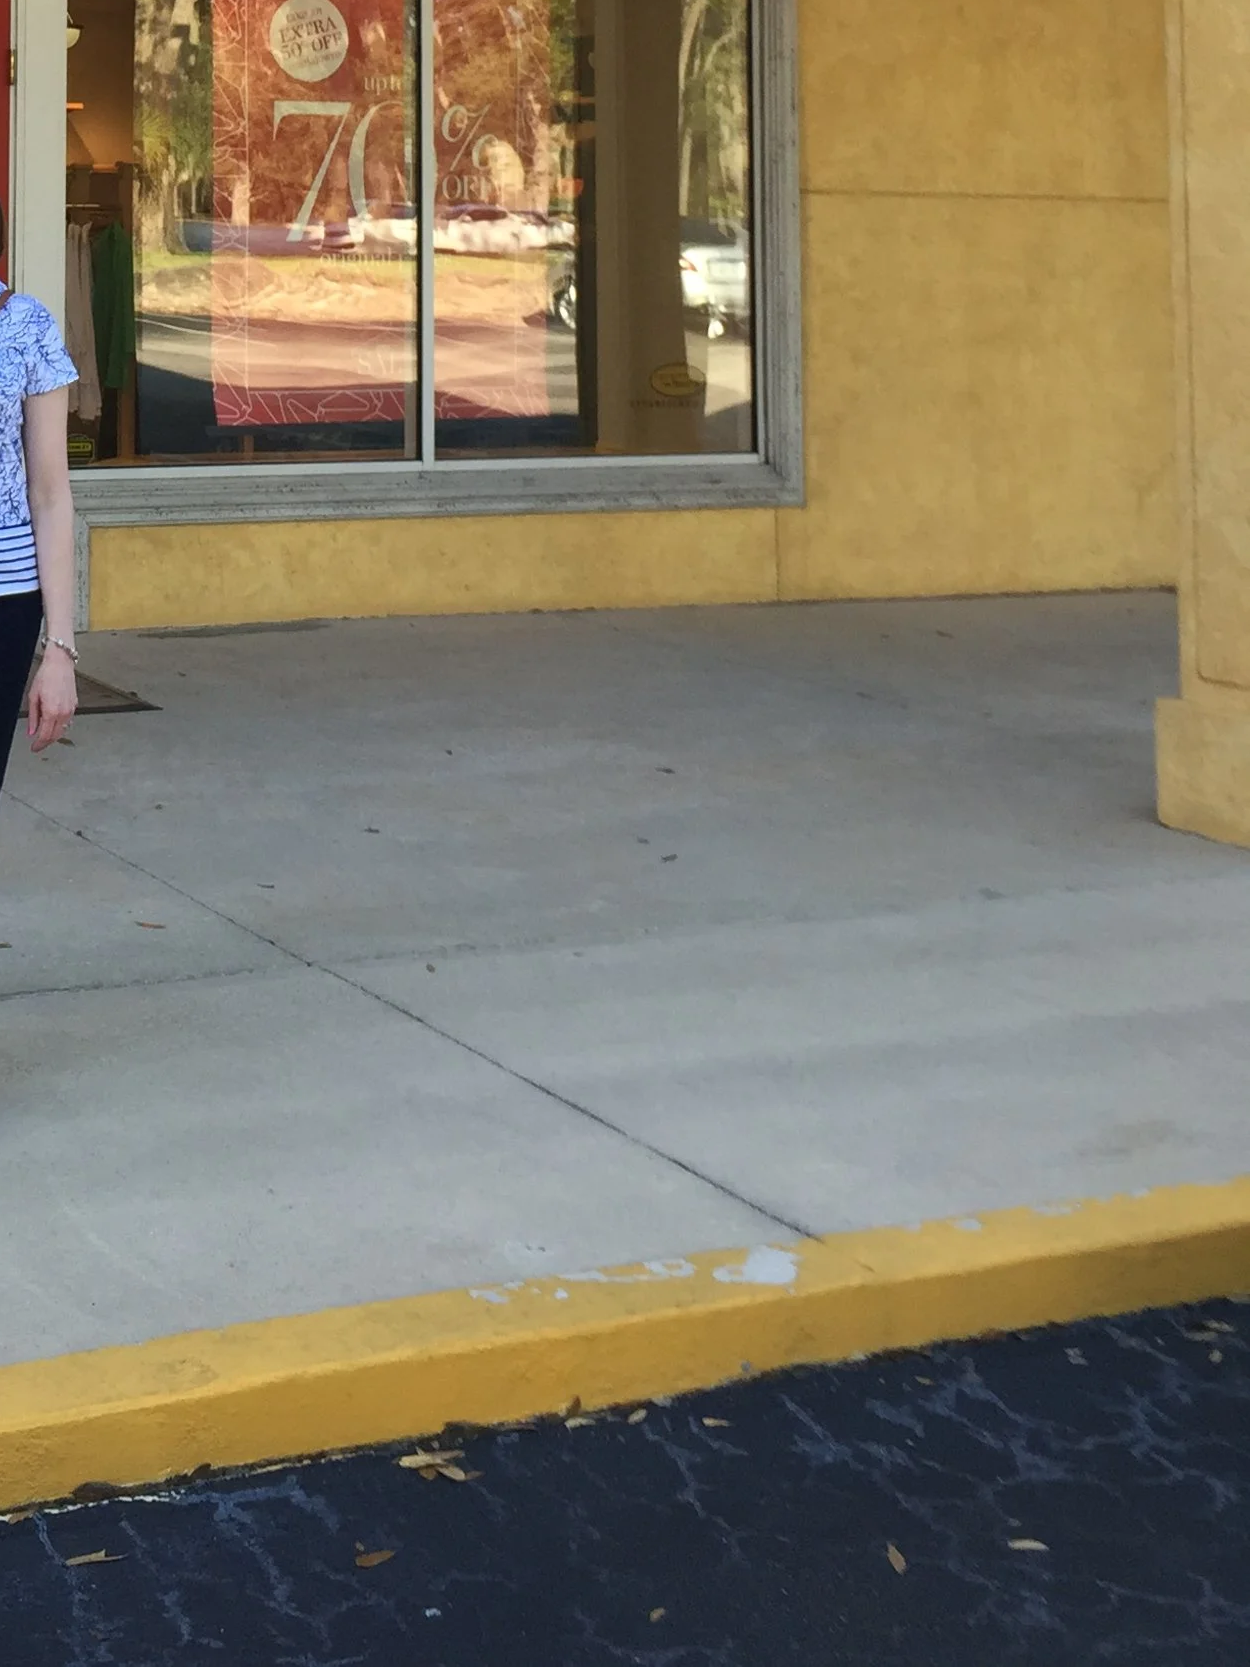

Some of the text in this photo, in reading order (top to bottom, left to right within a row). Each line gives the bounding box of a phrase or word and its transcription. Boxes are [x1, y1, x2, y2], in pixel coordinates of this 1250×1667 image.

[279, 16, 338, 43] EXTRA
[311, 31, 343, 52] OFF
[363, 76, 388, 96] up
